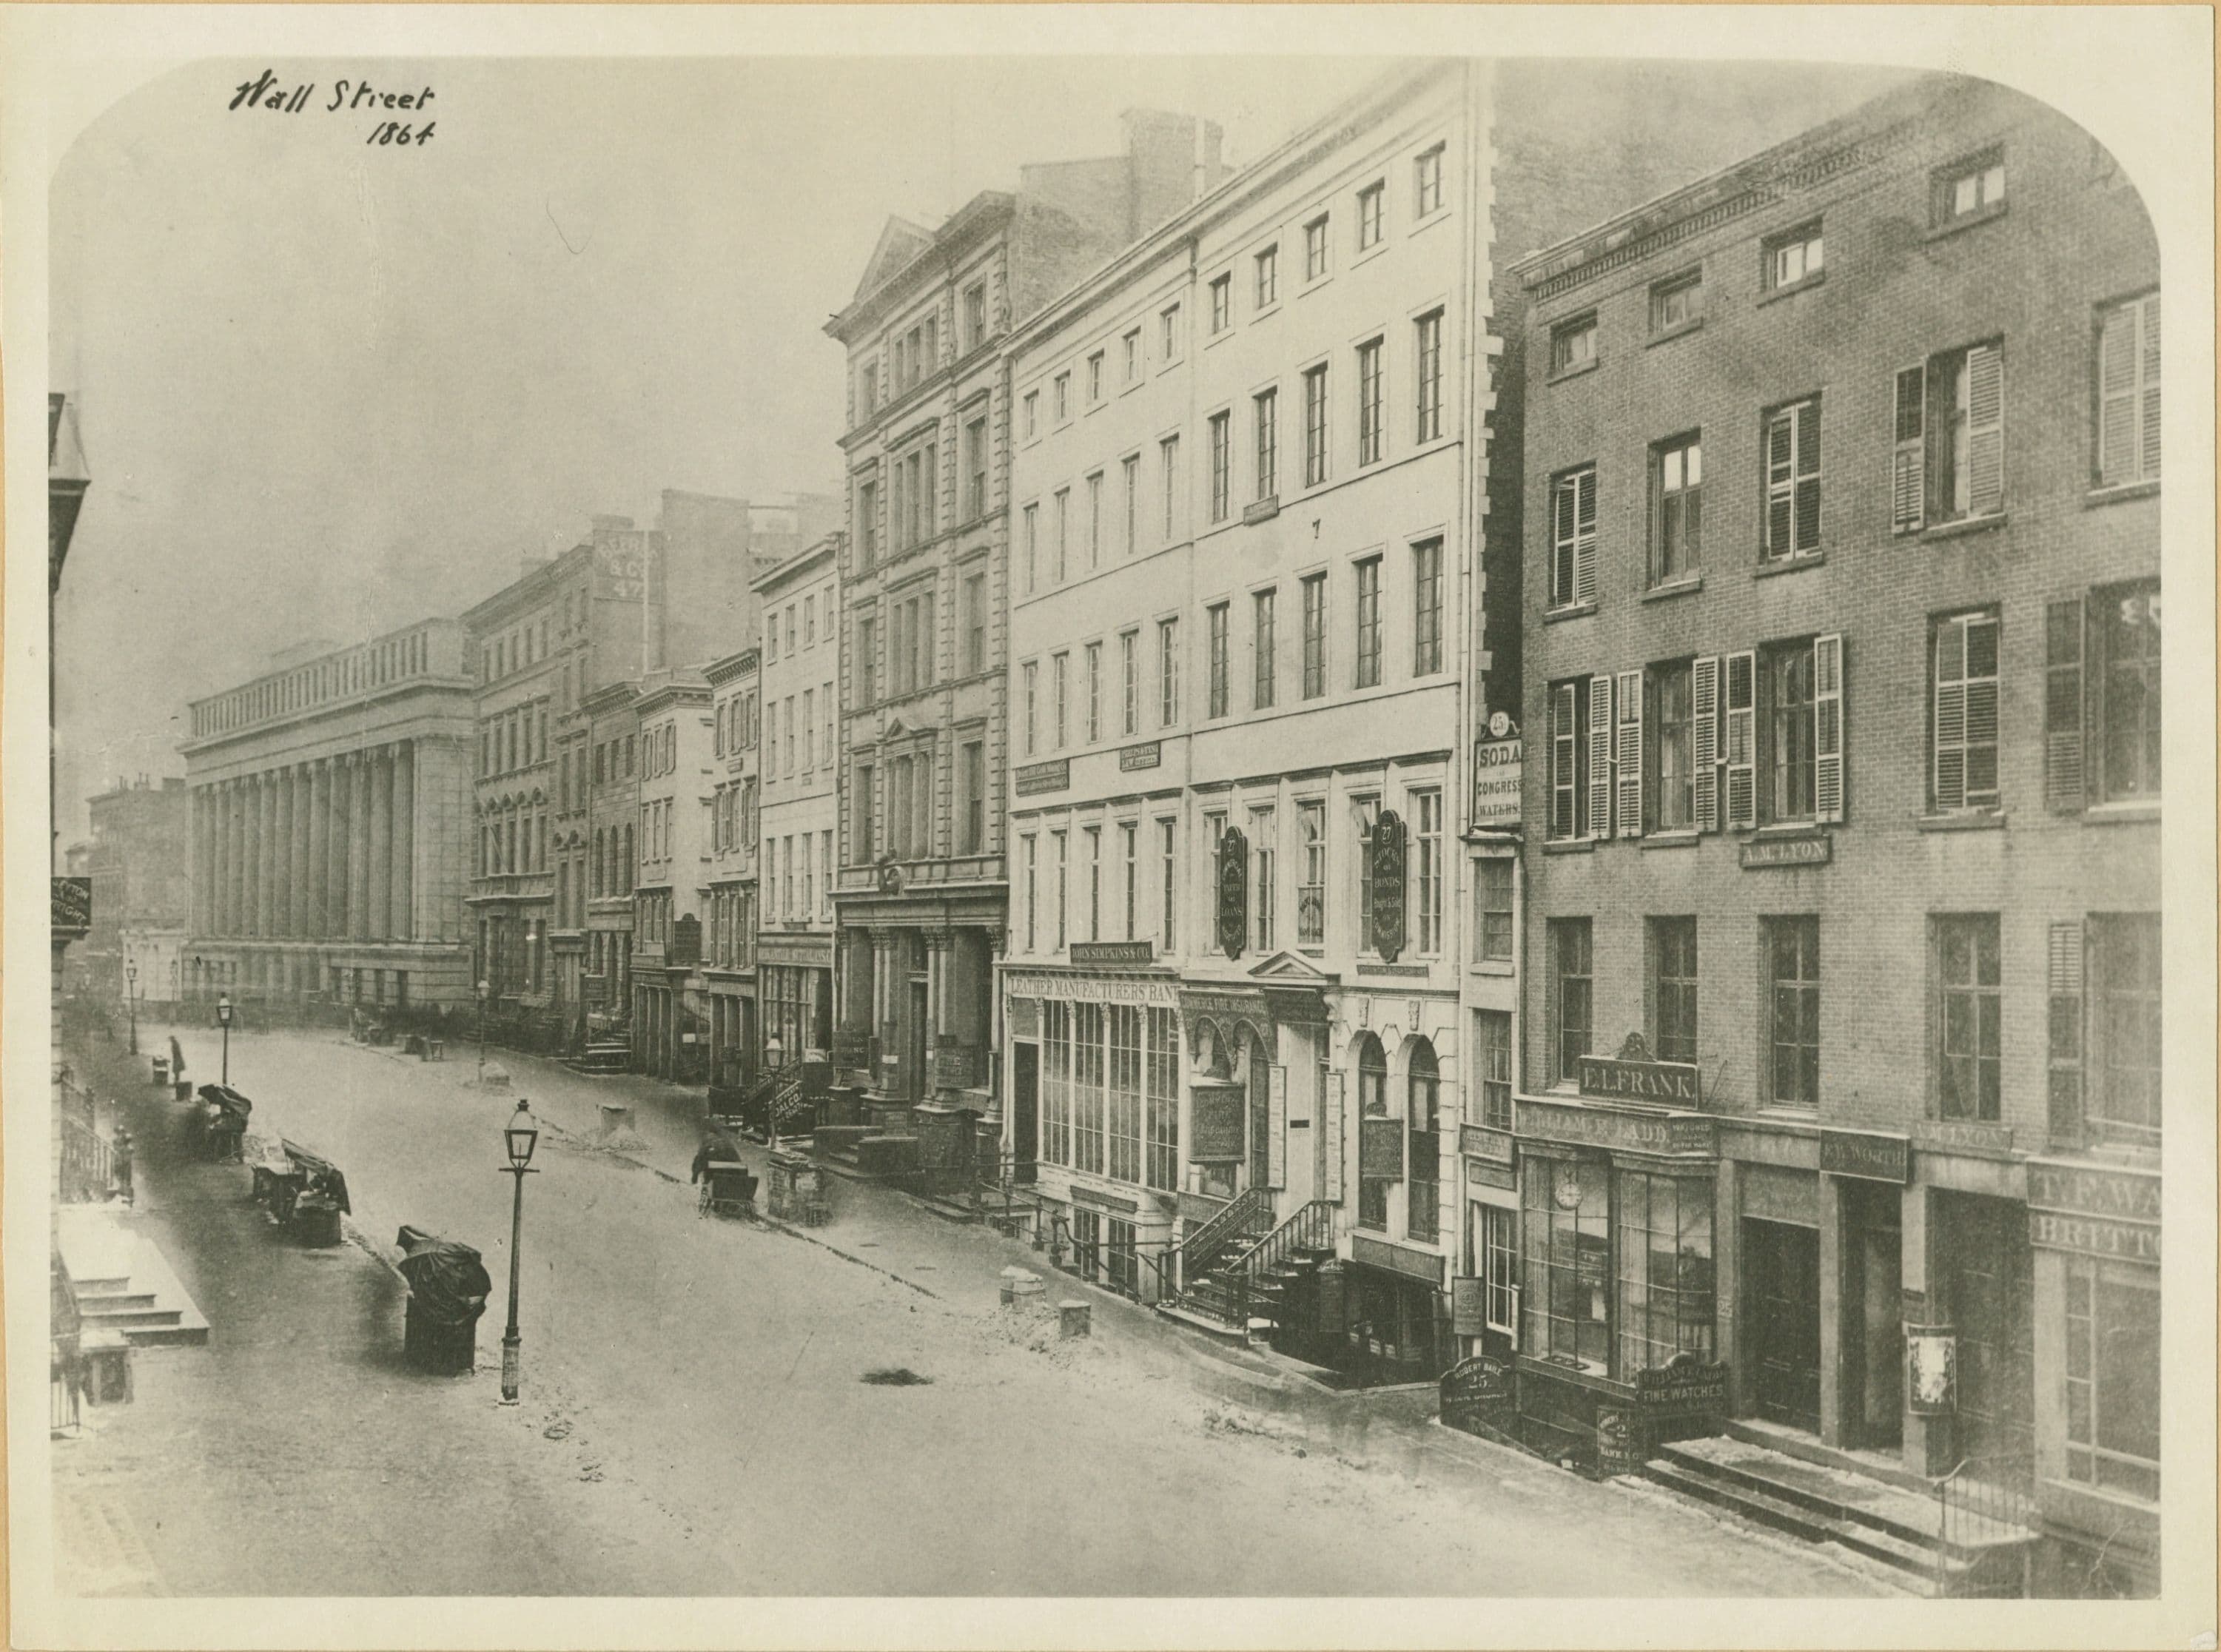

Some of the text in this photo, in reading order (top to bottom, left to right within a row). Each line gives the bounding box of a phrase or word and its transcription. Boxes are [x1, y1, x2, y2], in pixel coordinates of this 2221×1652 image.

[1493, 715, 1505, 731] 25
[1479, 745, 1522, 768] SODA
[1477, 779, 1522, 796] CONGRESS
[1382, 827, 1391, 840] 27
[1012, 978, 1052, 995] LEATHER
[1644, 1384, 1724, 1403] FINE WATCHES
